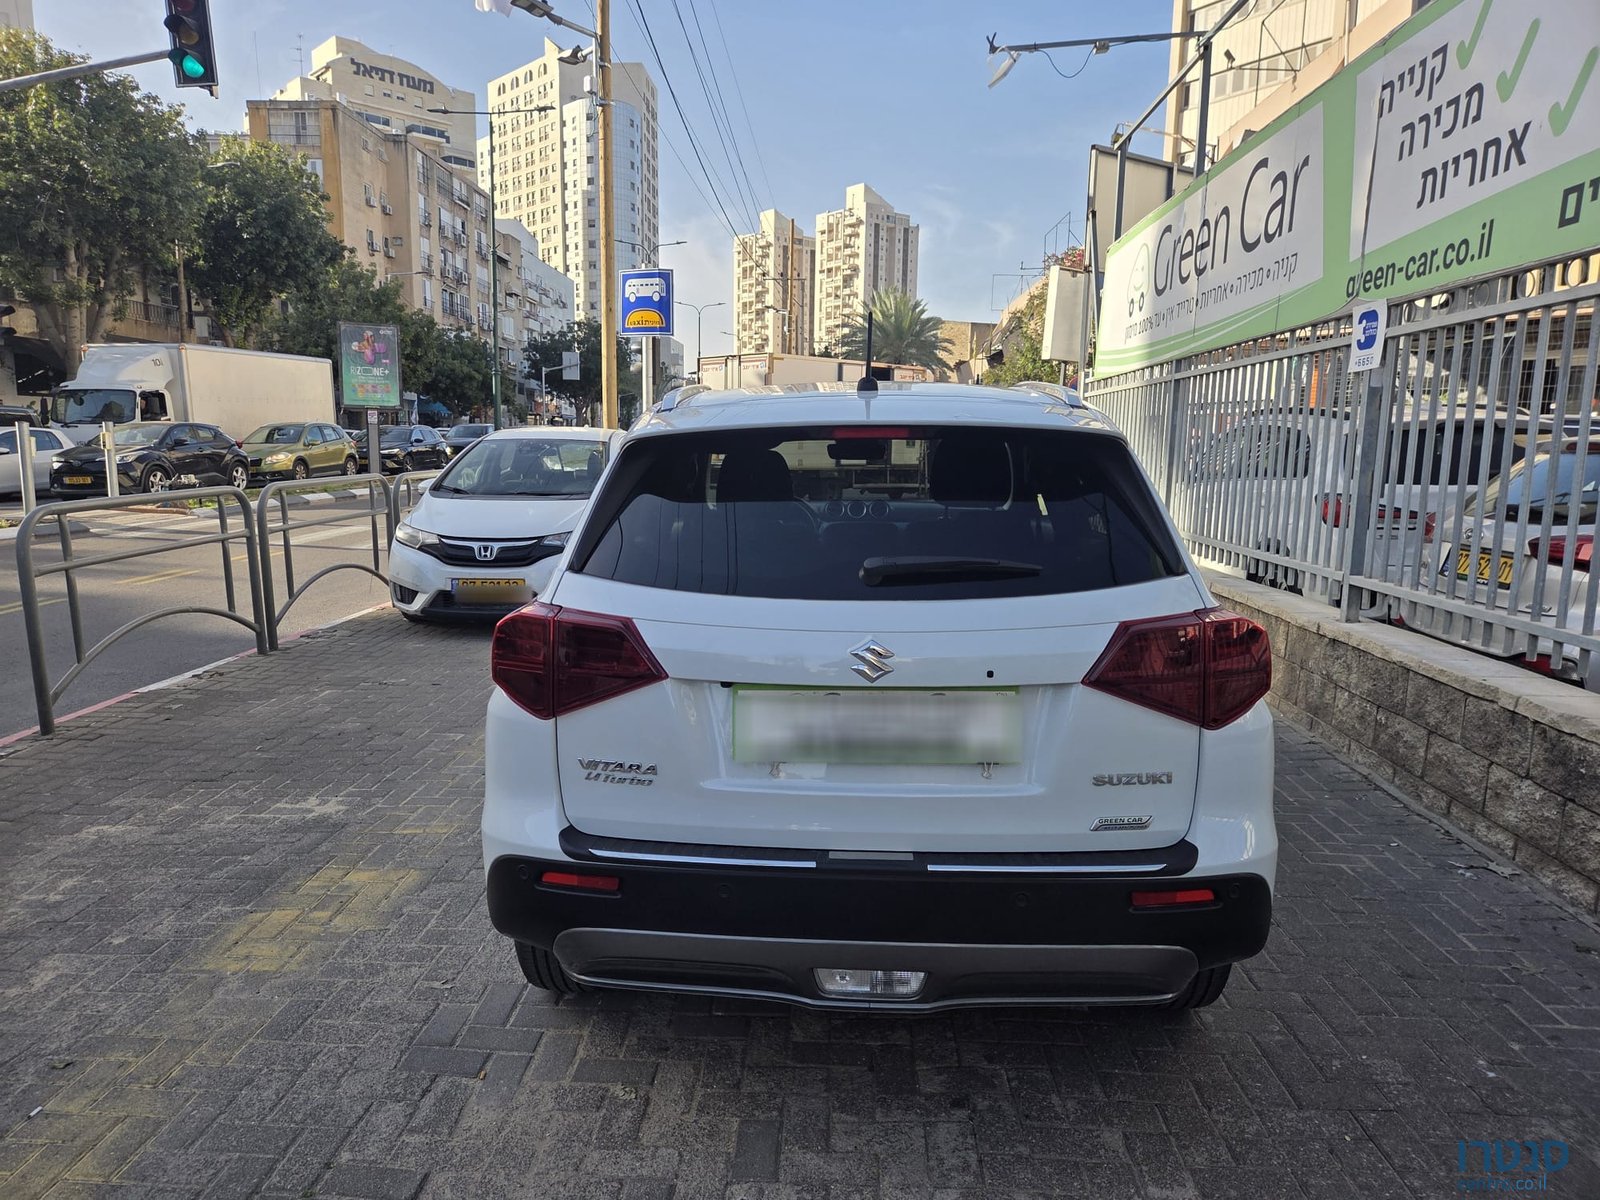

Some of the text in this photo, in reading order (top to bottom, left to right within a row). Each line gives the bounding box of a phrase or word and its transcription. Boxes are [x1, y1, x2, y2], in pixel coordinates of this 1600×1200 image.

[1379, 42, 1449, 118] קנייה
[1398, 81, 1484, 161] מכירה
[1416, 120, 1533, 209] אחריות
[1153, 155, 1310, 297] Green Car
[1235, 267, 1264, 295] מכירה
[1272, 252, 1298, 282] קניה
[1346, 218, 1495, 299] green-car.co.il
[1199, 281, 1230, 310] אחריות
[577, 757, 658, 776] VITARA
[1091, 771, 1173, 787] SUZUKI
